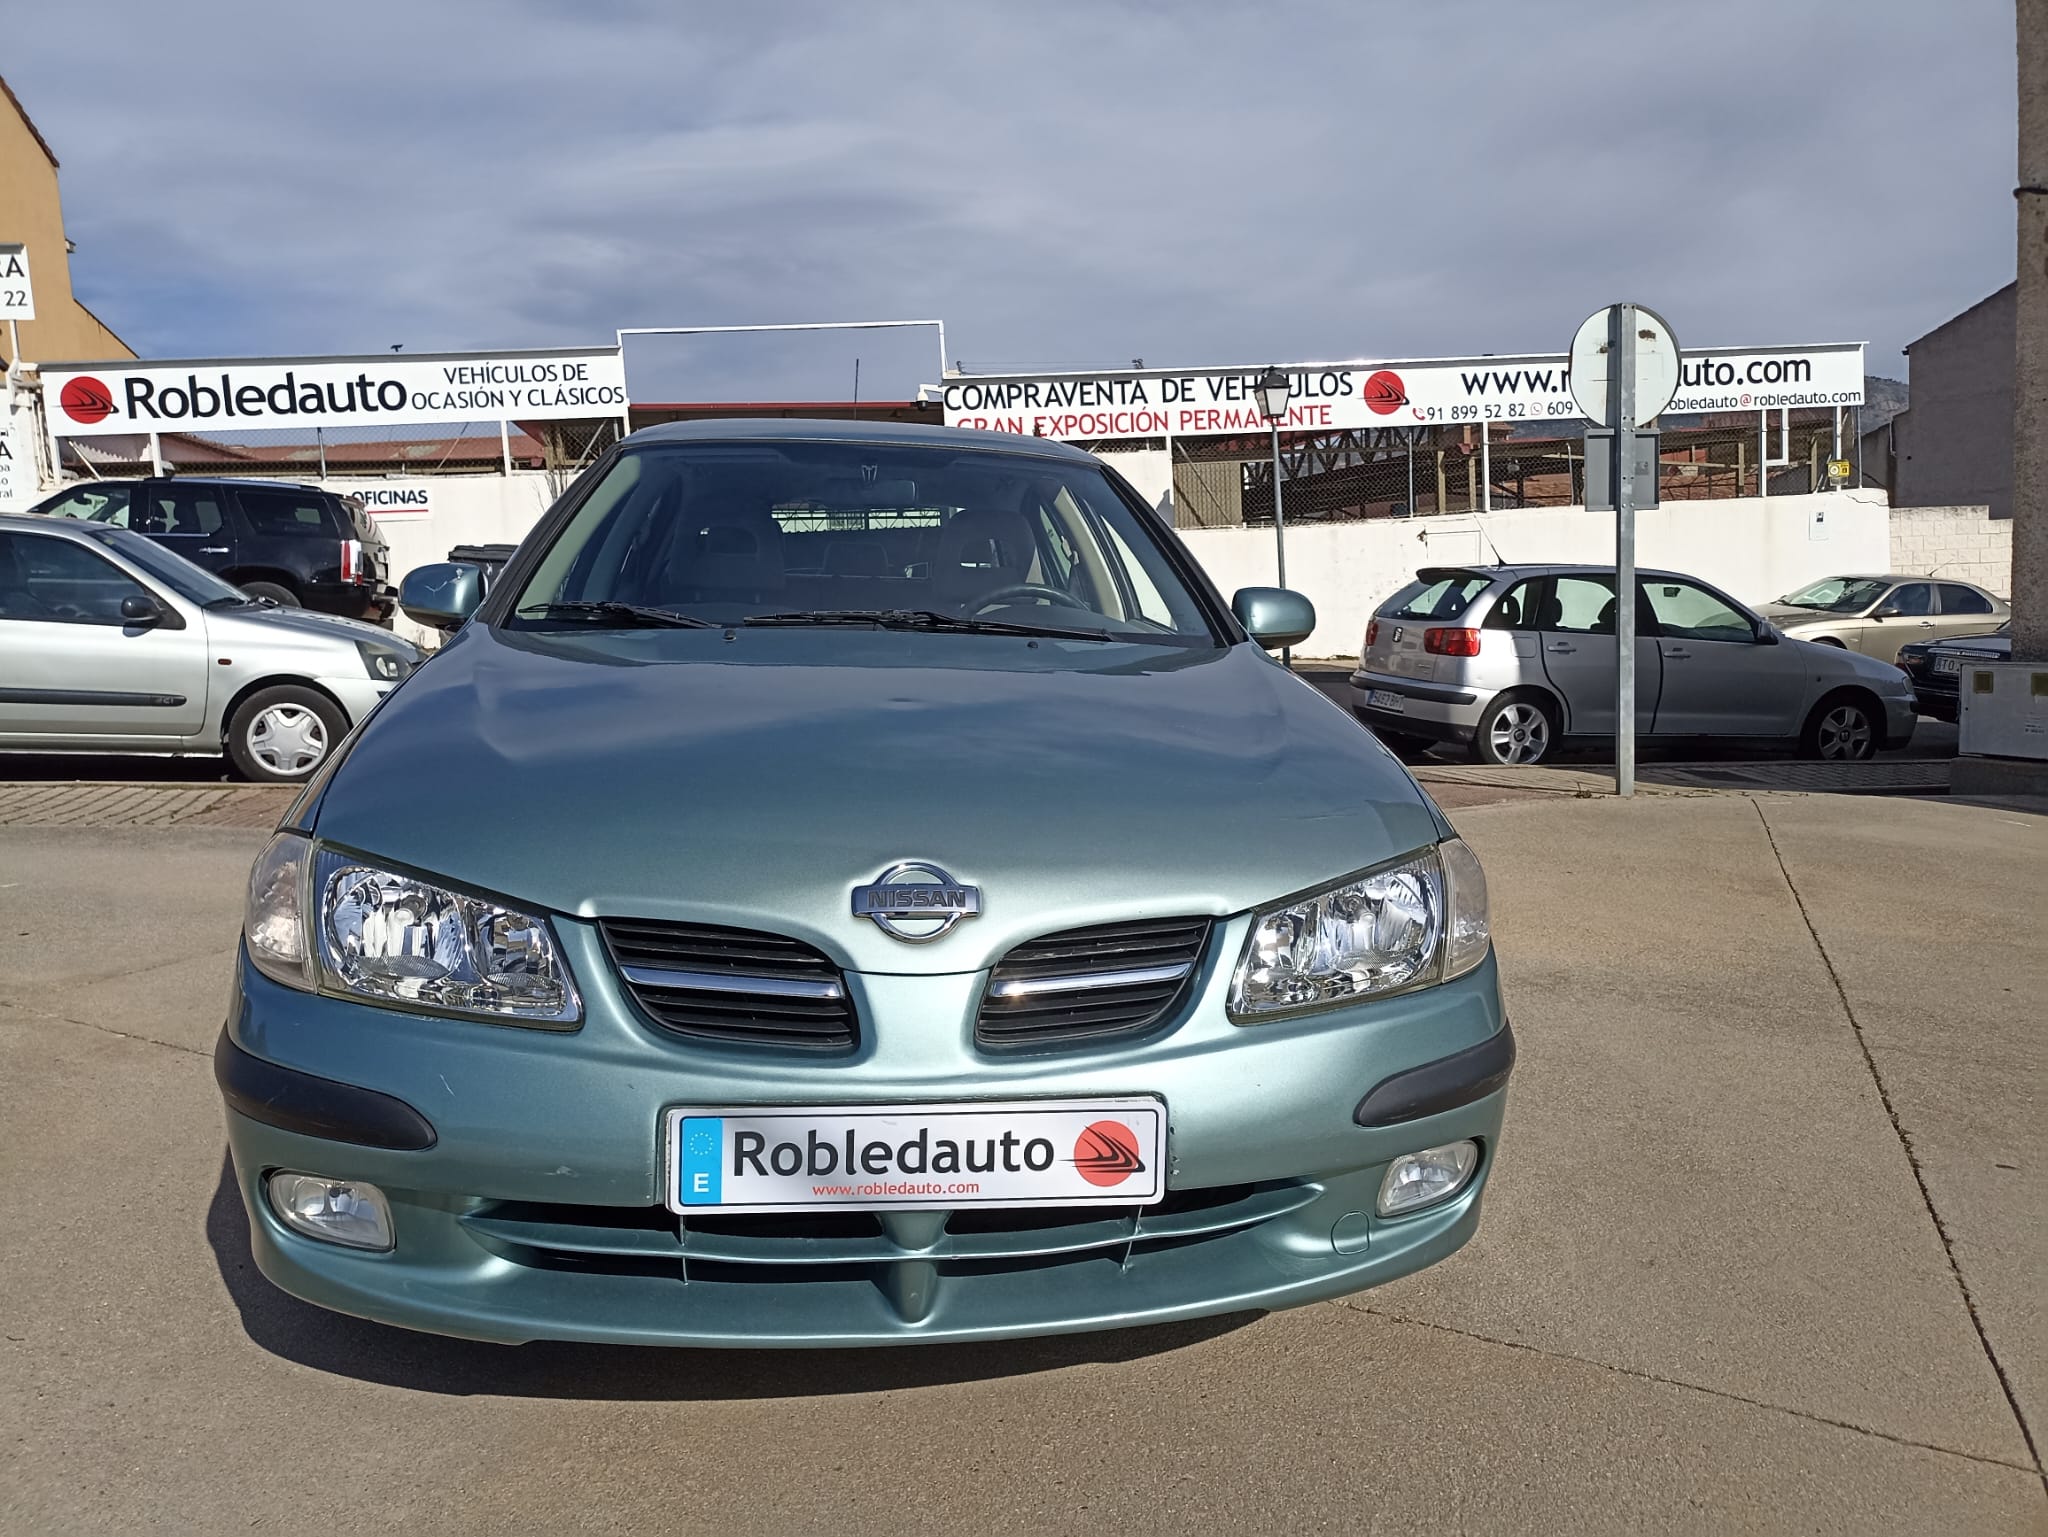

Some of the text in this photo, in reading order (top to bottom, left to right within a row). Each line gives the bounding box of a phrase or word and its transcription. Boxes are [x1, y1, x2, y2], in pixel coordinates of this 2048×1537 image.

[443, 362, 589, 385] VEHÍCULOS DE
[124, 371, 407, 420] Robledauto
[411, 384, 625, 410] OCASIÓN Y CLÁSICOS
[943, 371, 1353, 411] COMPRAVENTA DE VEHULOS
[1034, 406, 1169, 438] EXPOSICIÓN
[1427, 401, 1573, 420] 91 899 52 82 609
[351, 489, 428, 505] OFICINAS
[868, 889, 966, 908] NISSAN
[733, 1128, 1055, 1178] Robledauto
[693, 1173, 709, 1193] E
[812, 1180, 980, 1197] www.robledauto.com
